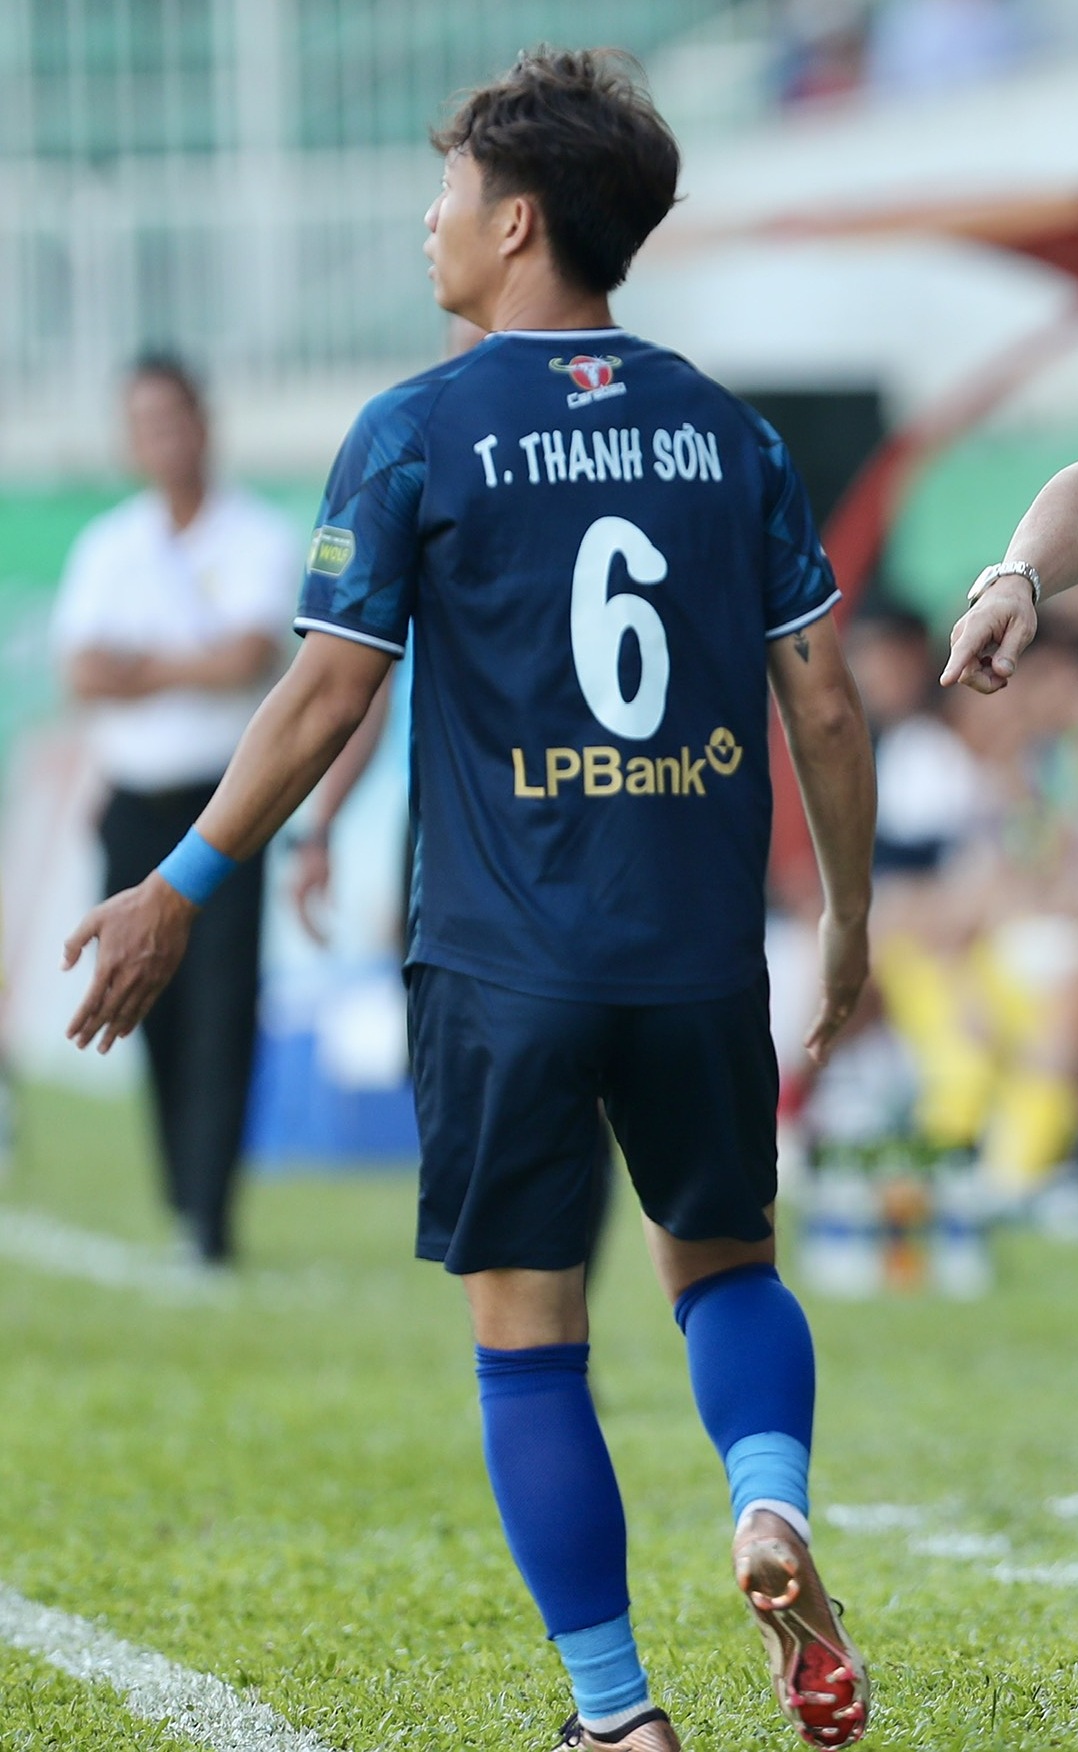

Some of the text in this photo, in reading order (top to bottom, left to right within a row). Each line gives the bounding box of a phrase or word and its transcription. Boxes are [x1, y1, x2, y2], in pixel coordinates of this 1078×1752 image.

[474, 422, 723, 487] T. THANH SƠN
[570, 515, 670, 740] 6
[512, 745, 707, 798] LPBank
